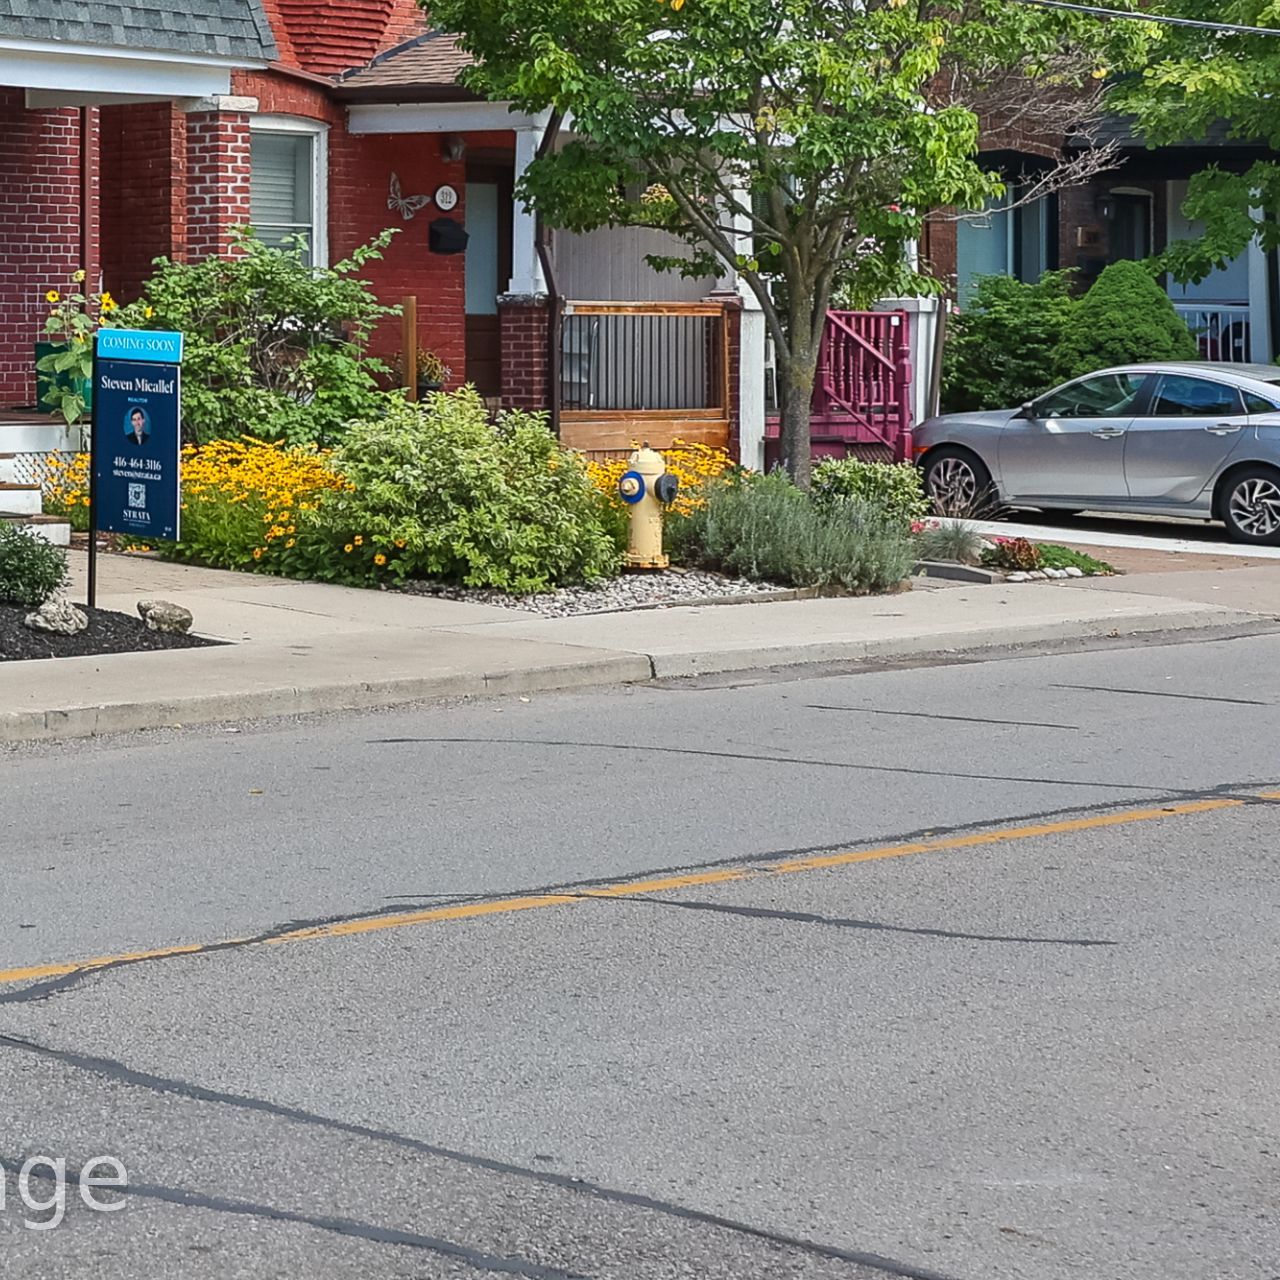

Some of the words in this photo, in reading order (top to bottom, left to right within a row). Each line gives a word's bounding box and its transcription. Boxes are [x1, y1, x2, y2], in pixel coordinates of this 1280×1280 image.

[102, 336, 145, 350] COMING
[146, 338, 176, 352] SOON
[101, 375, 133, 391] Steven
[134, 377, 175, 394] Micallef
[123, 509, 151, 521] STRATA
